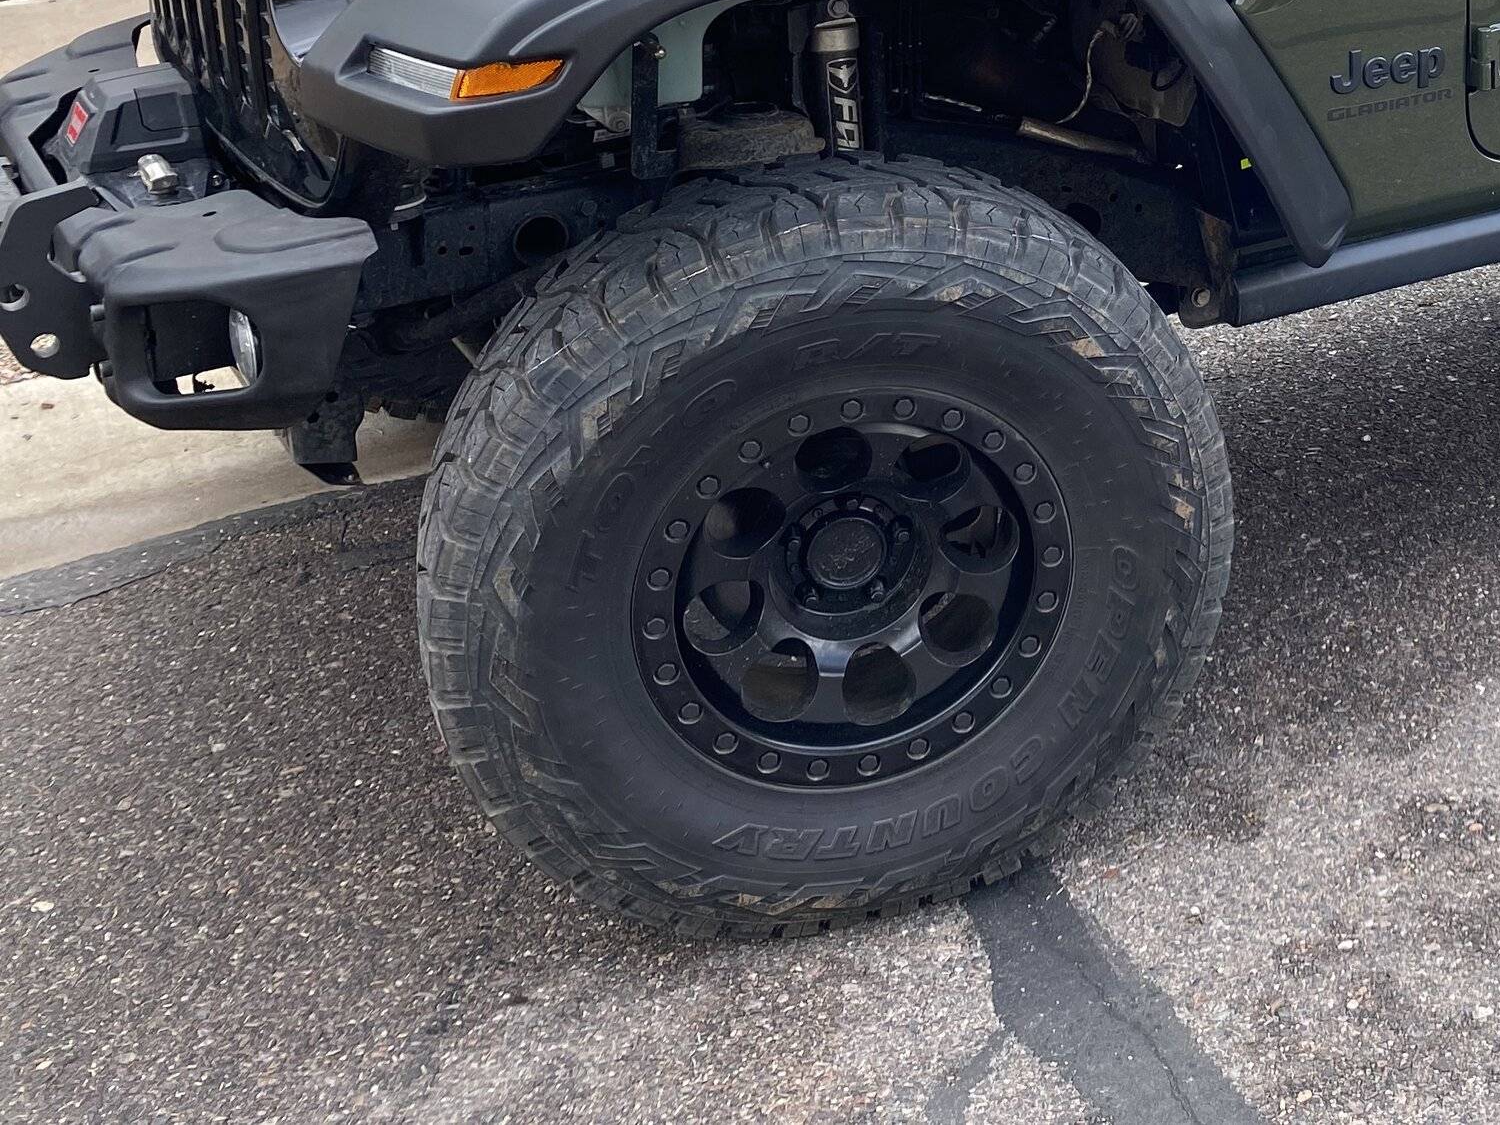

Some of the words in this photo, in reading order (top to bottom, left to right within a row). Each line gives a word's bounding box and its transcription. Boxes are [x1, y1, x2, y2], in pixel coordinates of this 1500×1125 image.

[1329, 46, 1446, 94] Jeep
[834, 96, 860, 151] FA
[1326, 87, 1454, 123] GLADIATOR
[1056, 543, 1143, 732] OPEN
[710, 733, 1048, 864] COUNTRY
